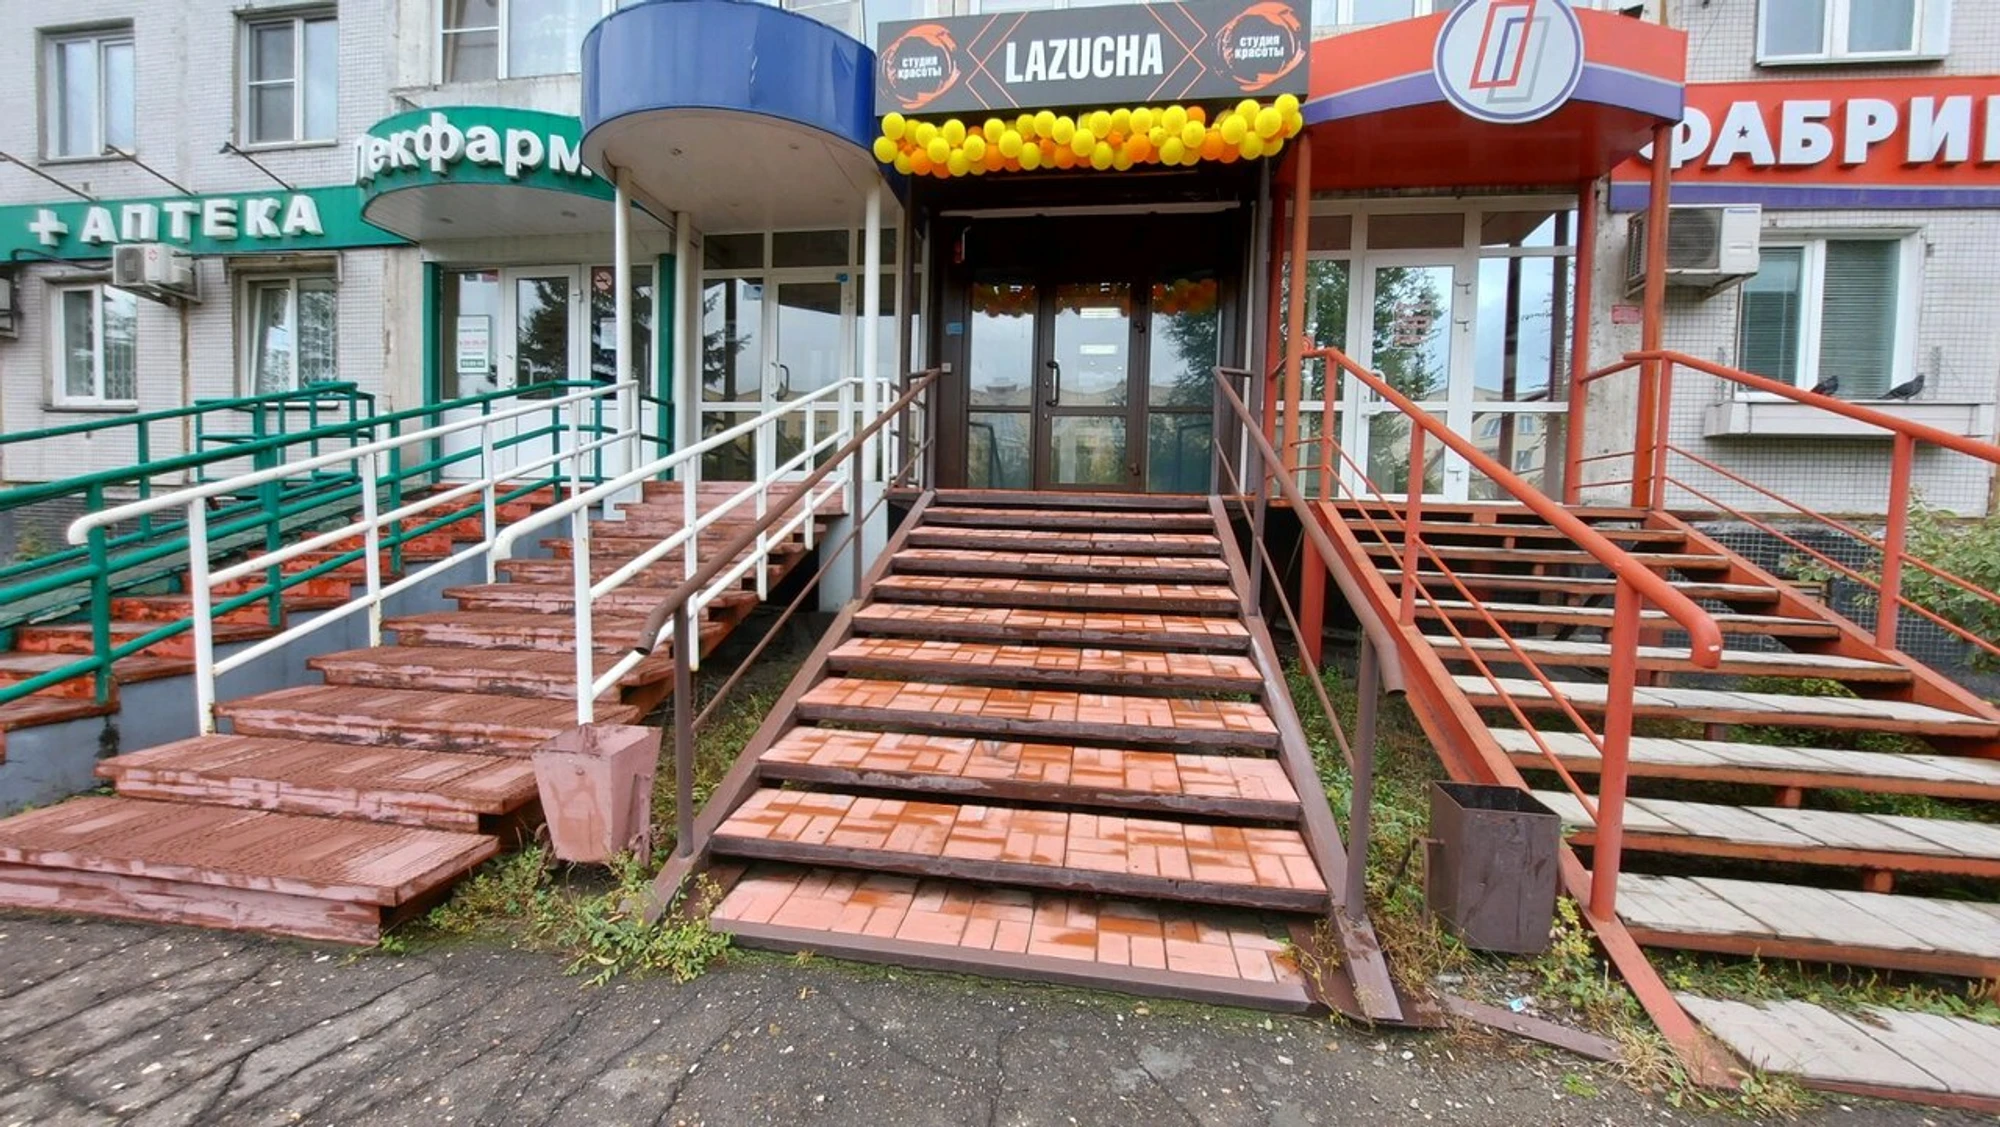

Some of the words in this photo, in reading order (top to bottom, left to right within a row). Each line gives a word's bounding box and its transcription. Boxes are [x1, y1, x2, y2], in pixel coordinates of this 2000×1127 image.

[1240, 35, 1280, 48] студия
[1005, 33, 1164, 83] LAZUCHA
[1234, 46, 1284, 60] красоты
[901, 56, 938, 69] студия
[897, 67, 942, 80] красоты
[1638, 94, 2000, 169] ФАБРИ
[79, 195, 324, 245] АПТЕКА
